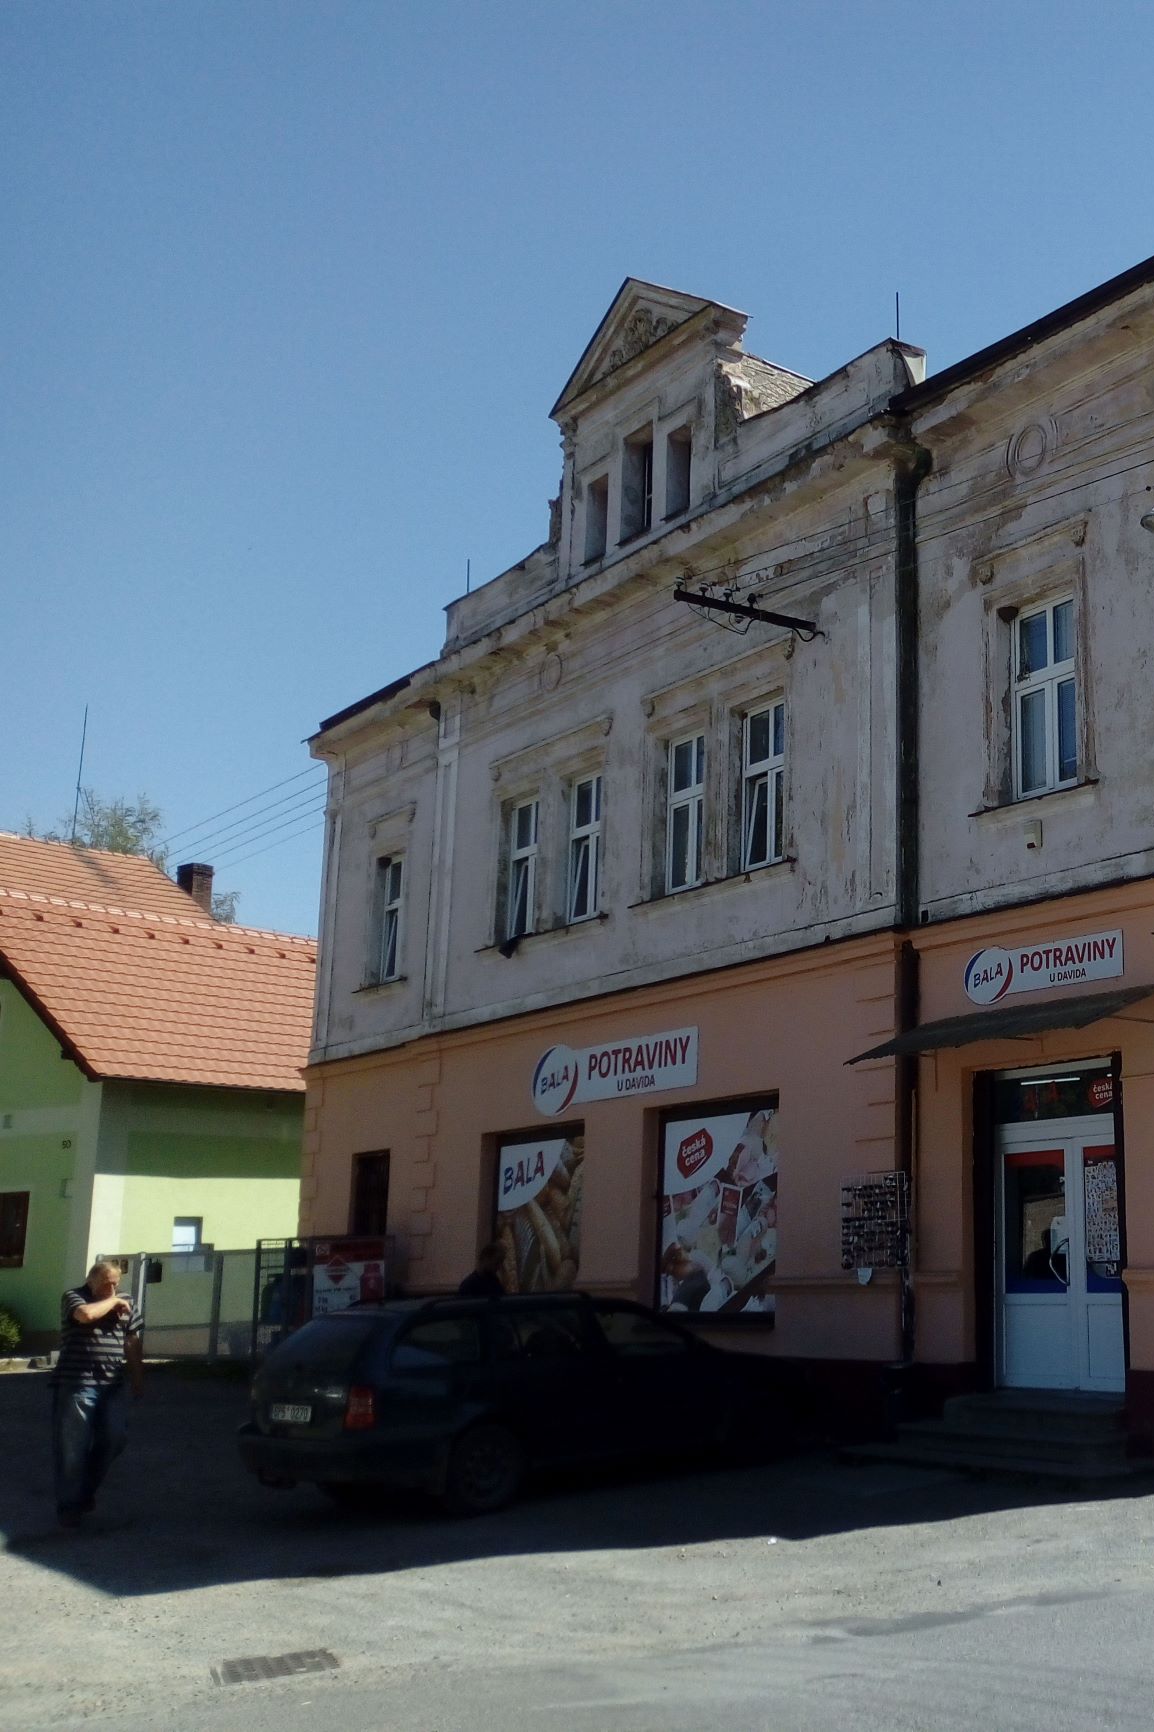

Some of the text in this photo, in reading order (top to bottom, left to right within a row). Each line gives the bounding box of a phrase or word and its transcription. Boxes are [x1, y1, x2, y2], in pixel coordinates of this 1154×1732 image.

[1020, 937, 1117, 974] POTRAVINY
[974, 962, 1003, 988] BALA
[1049, 968, 1086, 983] U DAVIDA
[588, 1035, 691, 1081] POTRAVINY
[540, 1066, 570, 1094] BALA
[617, 1075, 656, 1092] U DAVIDA
[685, 1148, 706, 1167] cena
[503, 1150, 545, 1195] BALA
